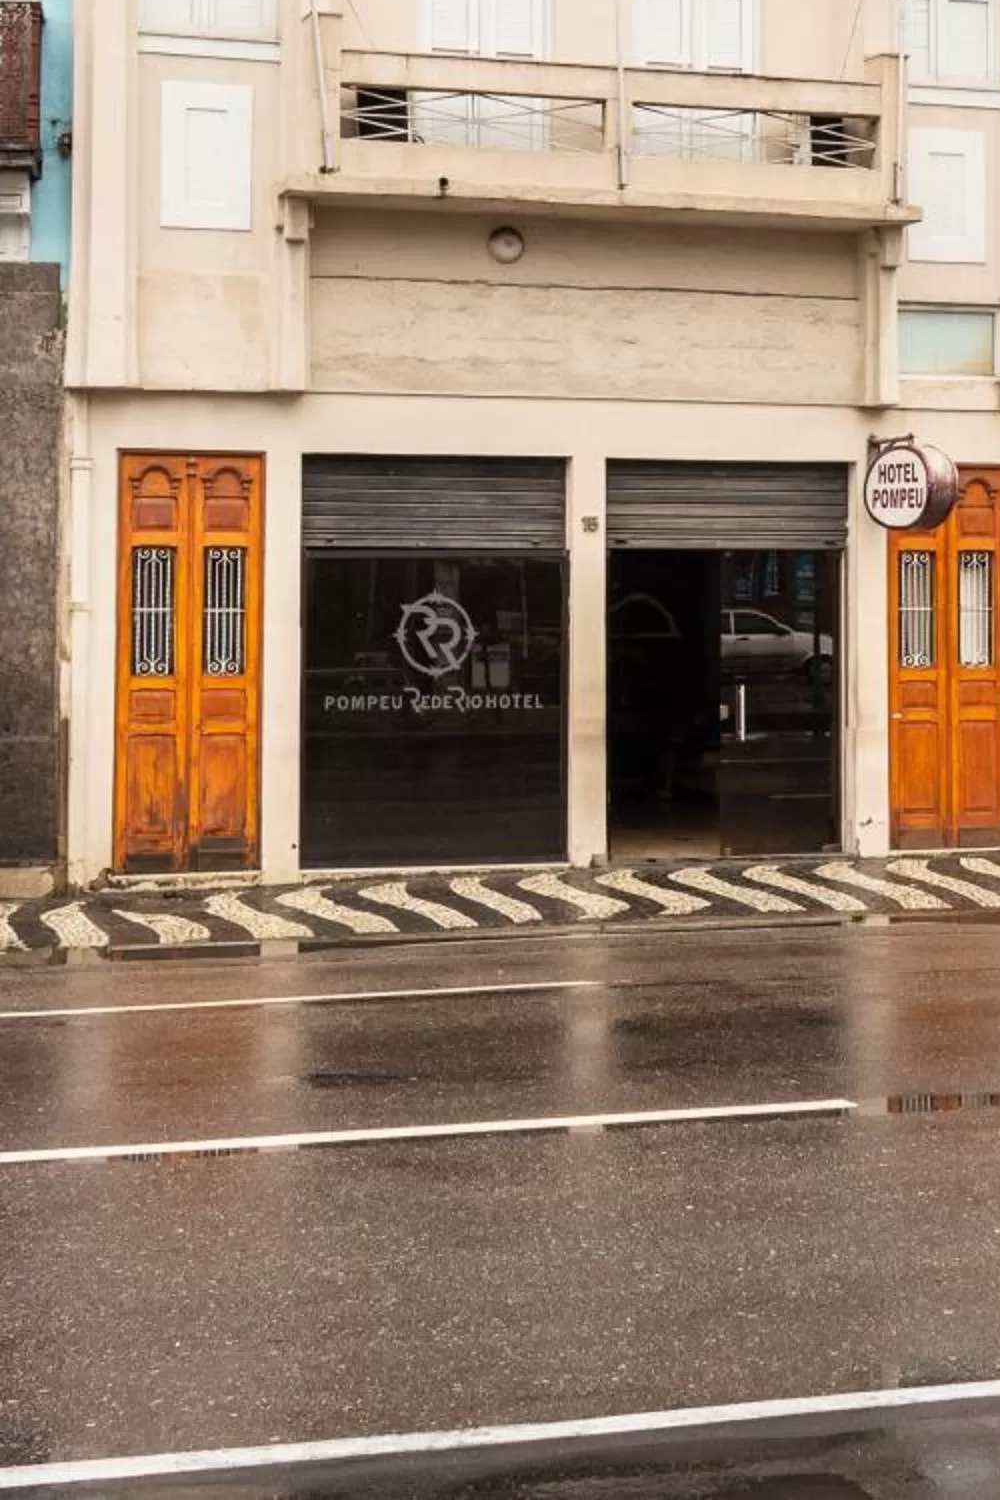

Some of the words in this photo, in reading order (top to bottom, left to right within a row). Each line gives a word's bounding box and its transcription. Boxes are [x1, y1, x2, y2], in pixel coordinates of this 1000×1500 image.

[878, 463, 919, 484] HOTEL
[872, 488, 924, 509] POMPEU
[323, 695, 402, 710] POMPEU
